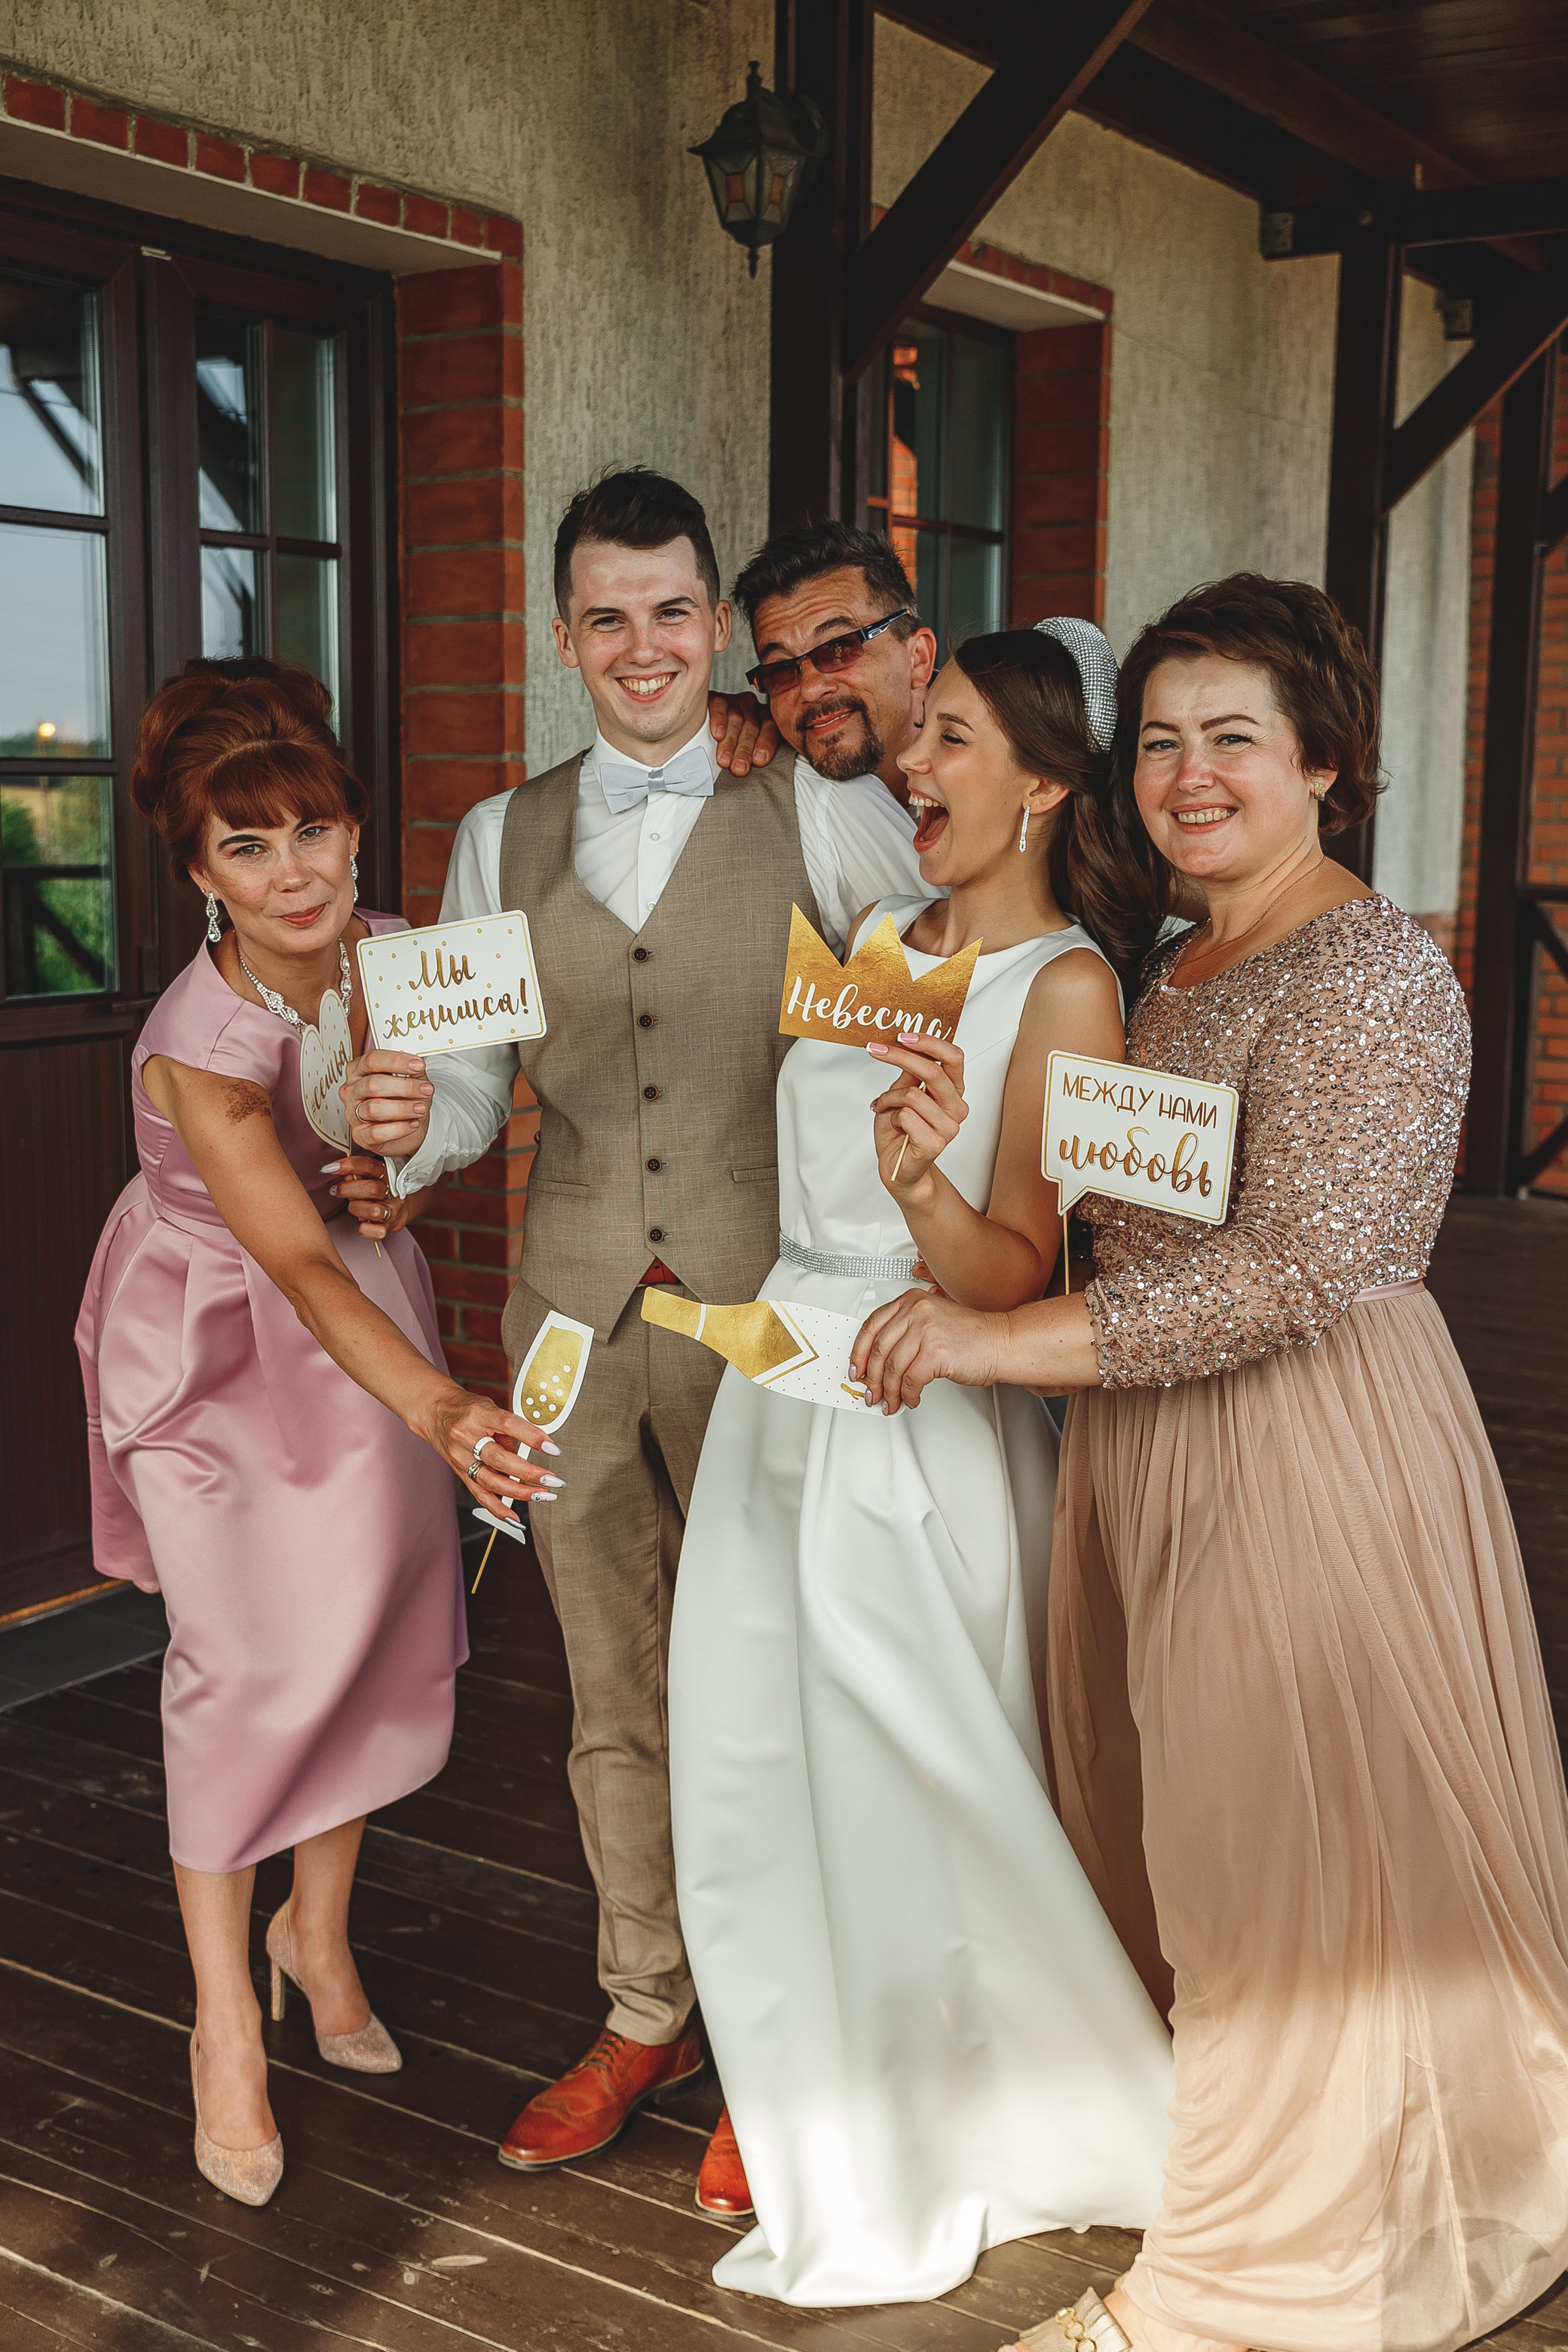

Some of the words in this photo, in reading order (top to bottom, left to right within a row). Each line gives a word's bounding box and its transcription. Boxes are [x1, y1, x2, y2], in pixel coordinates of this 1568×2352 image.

[409, 948, 476, 990] Мы
[383, 977, 528, 1039] женимся!
[787, 975, 952, 1040] Невеста
[1063, 1072, 1155, 1117] МЕЖДУ
[1159, 1092, 1217, 1129] НАМИ
[1059, 1126, 1212, 1198] любовь
